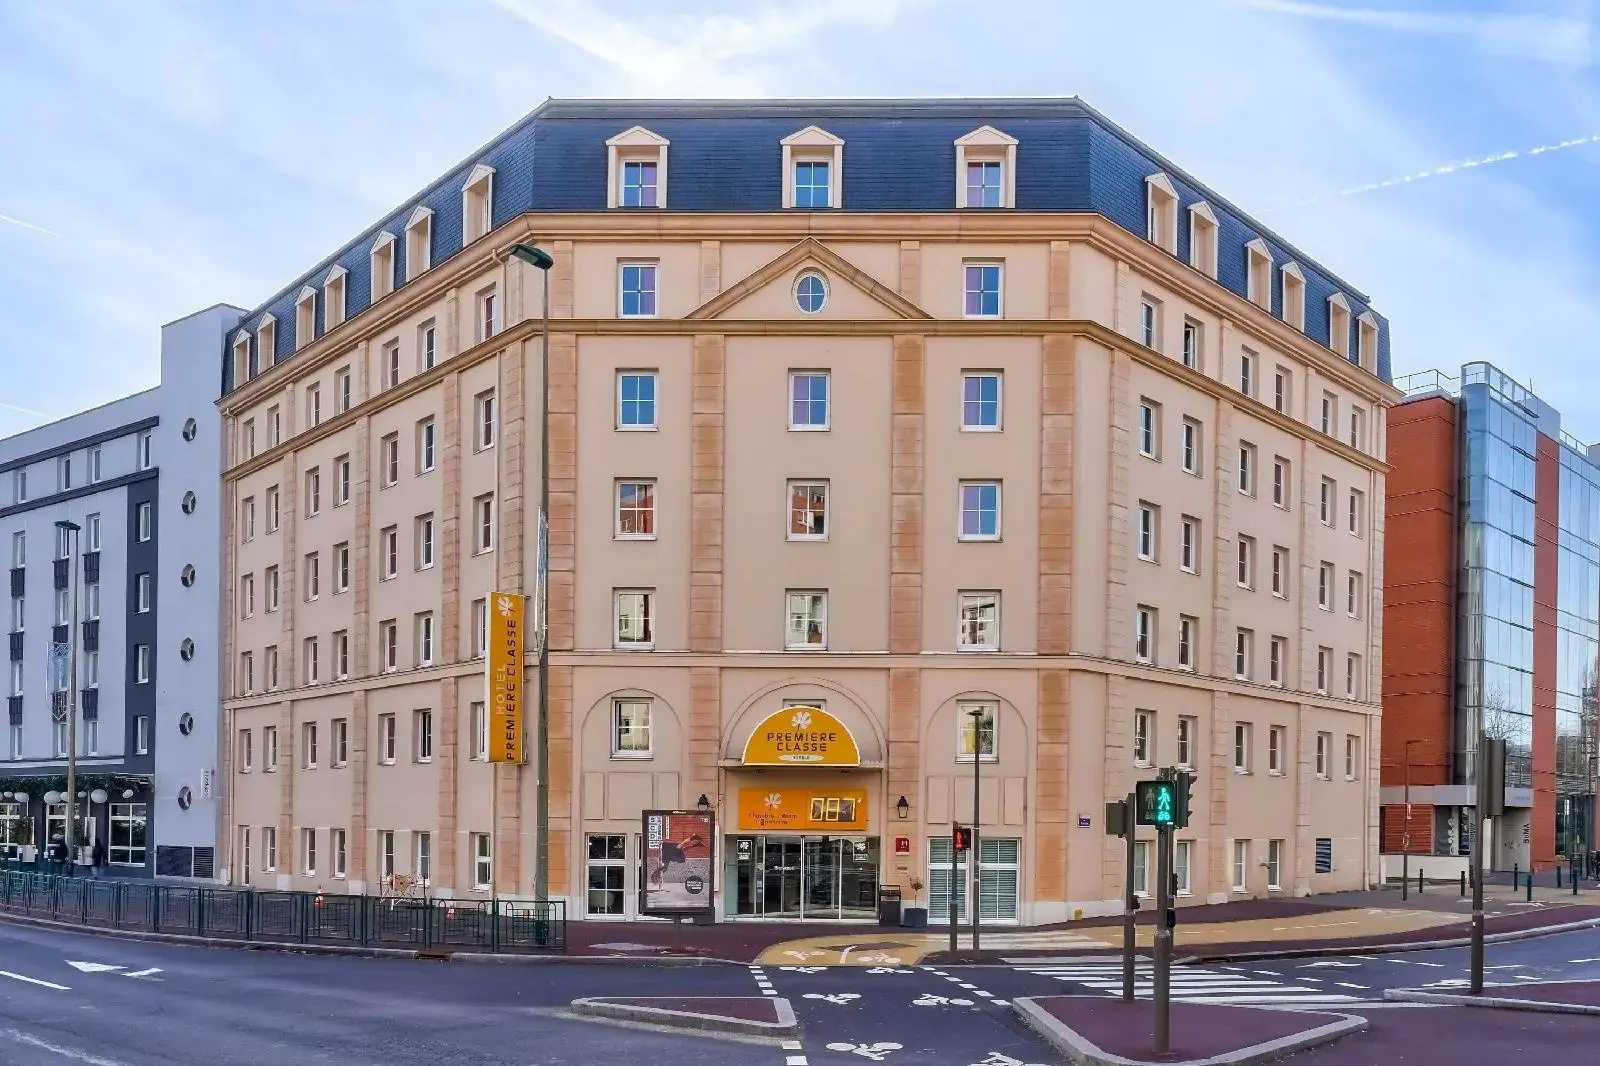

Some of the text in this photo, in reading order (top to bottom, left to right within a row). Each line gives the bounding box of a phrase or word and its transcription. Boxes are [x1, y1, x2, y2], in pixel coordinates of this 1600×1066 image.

[495, 664, 507, 715] HOTEL
[505, 619, 517, 761] PREMIERE CLASSE
[767, 732, 836, 742] PREMIERE
[776, 742, 827, 752] CLASSE
